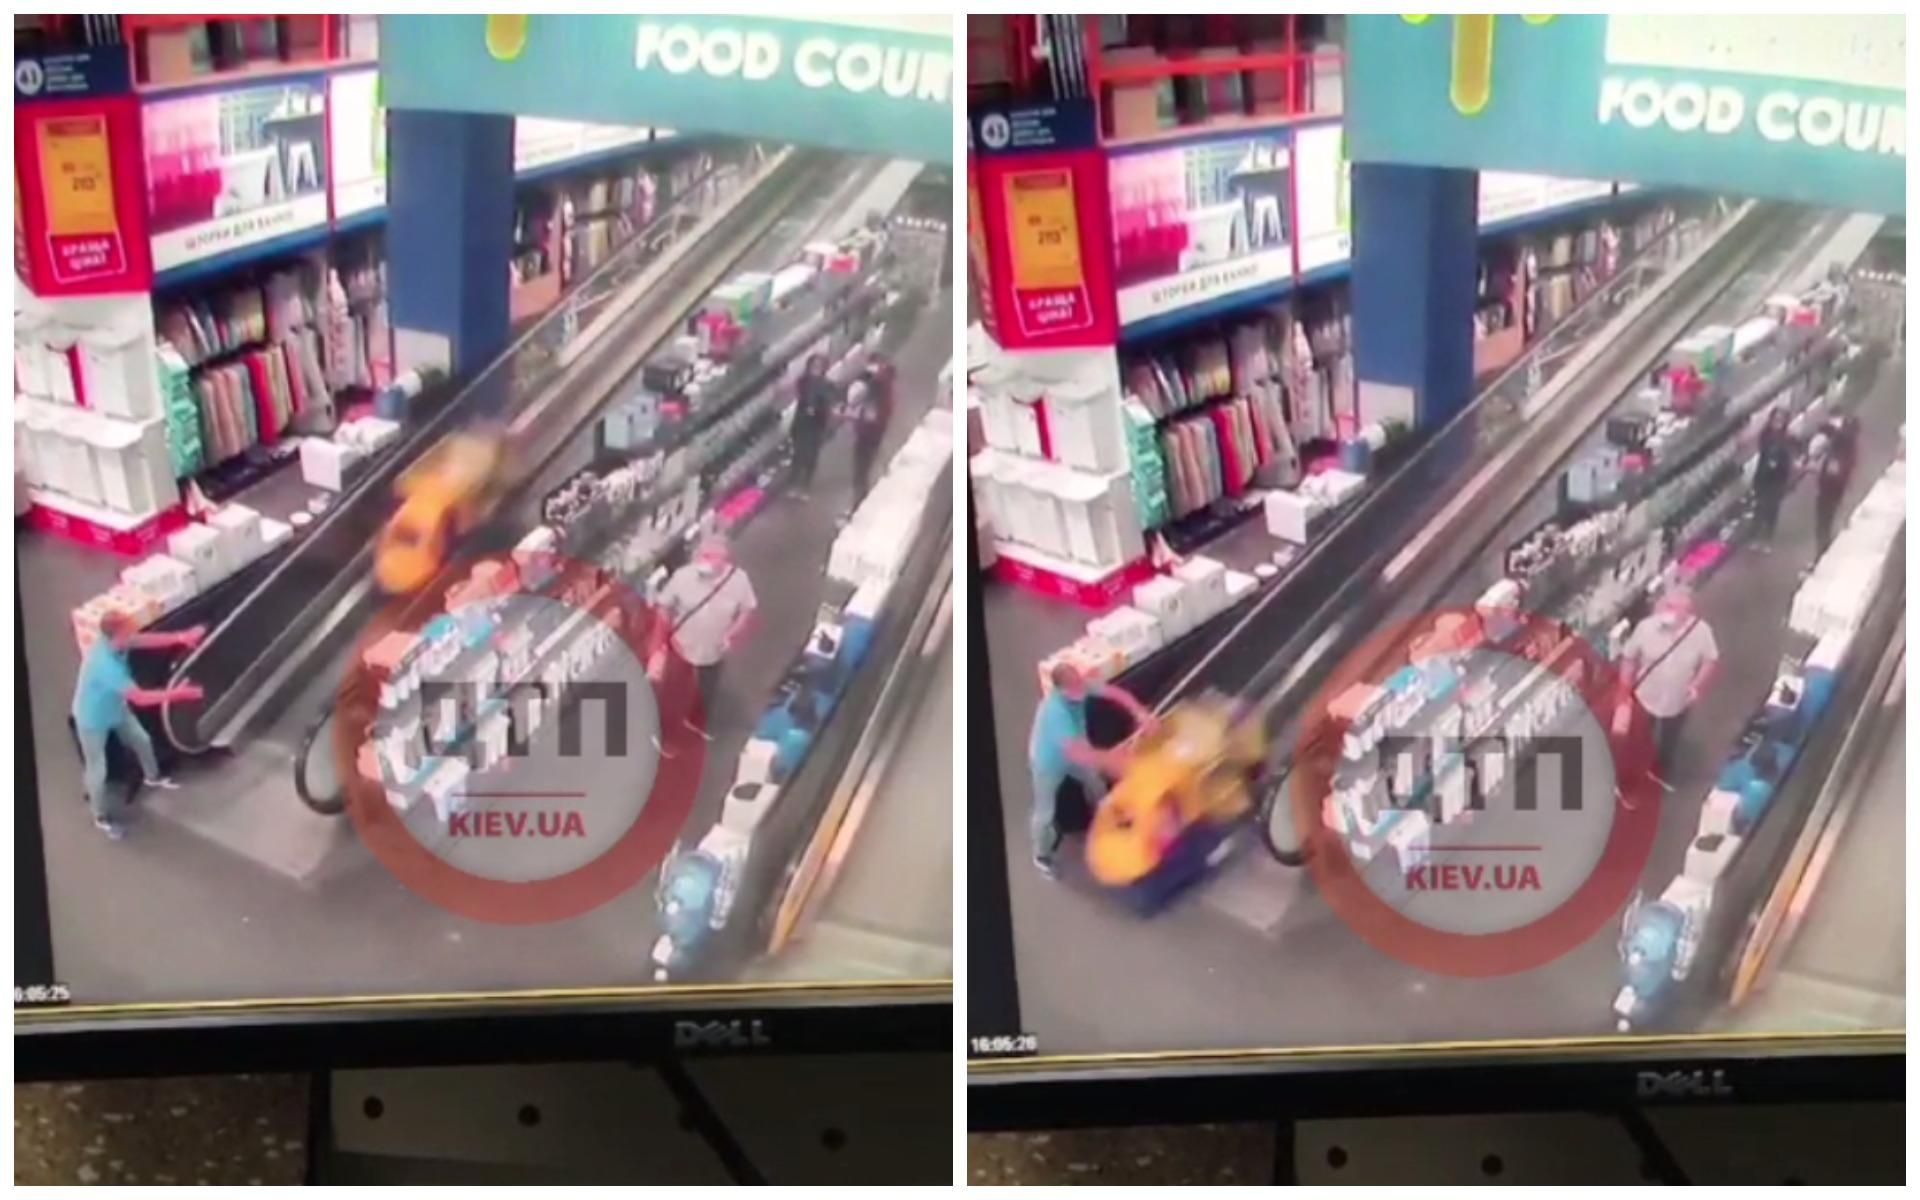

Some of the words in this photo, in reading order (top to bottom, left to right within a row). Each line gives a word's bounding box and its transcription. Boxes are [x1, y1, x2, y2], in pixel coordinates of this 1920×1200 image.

[635, 22, 781, 80] FOOD
[1599, 76, 1744, 134] FOOD
[675, 1019, 771, 1046] DELL
[1637, 1069, 1734, 1096] DELL
